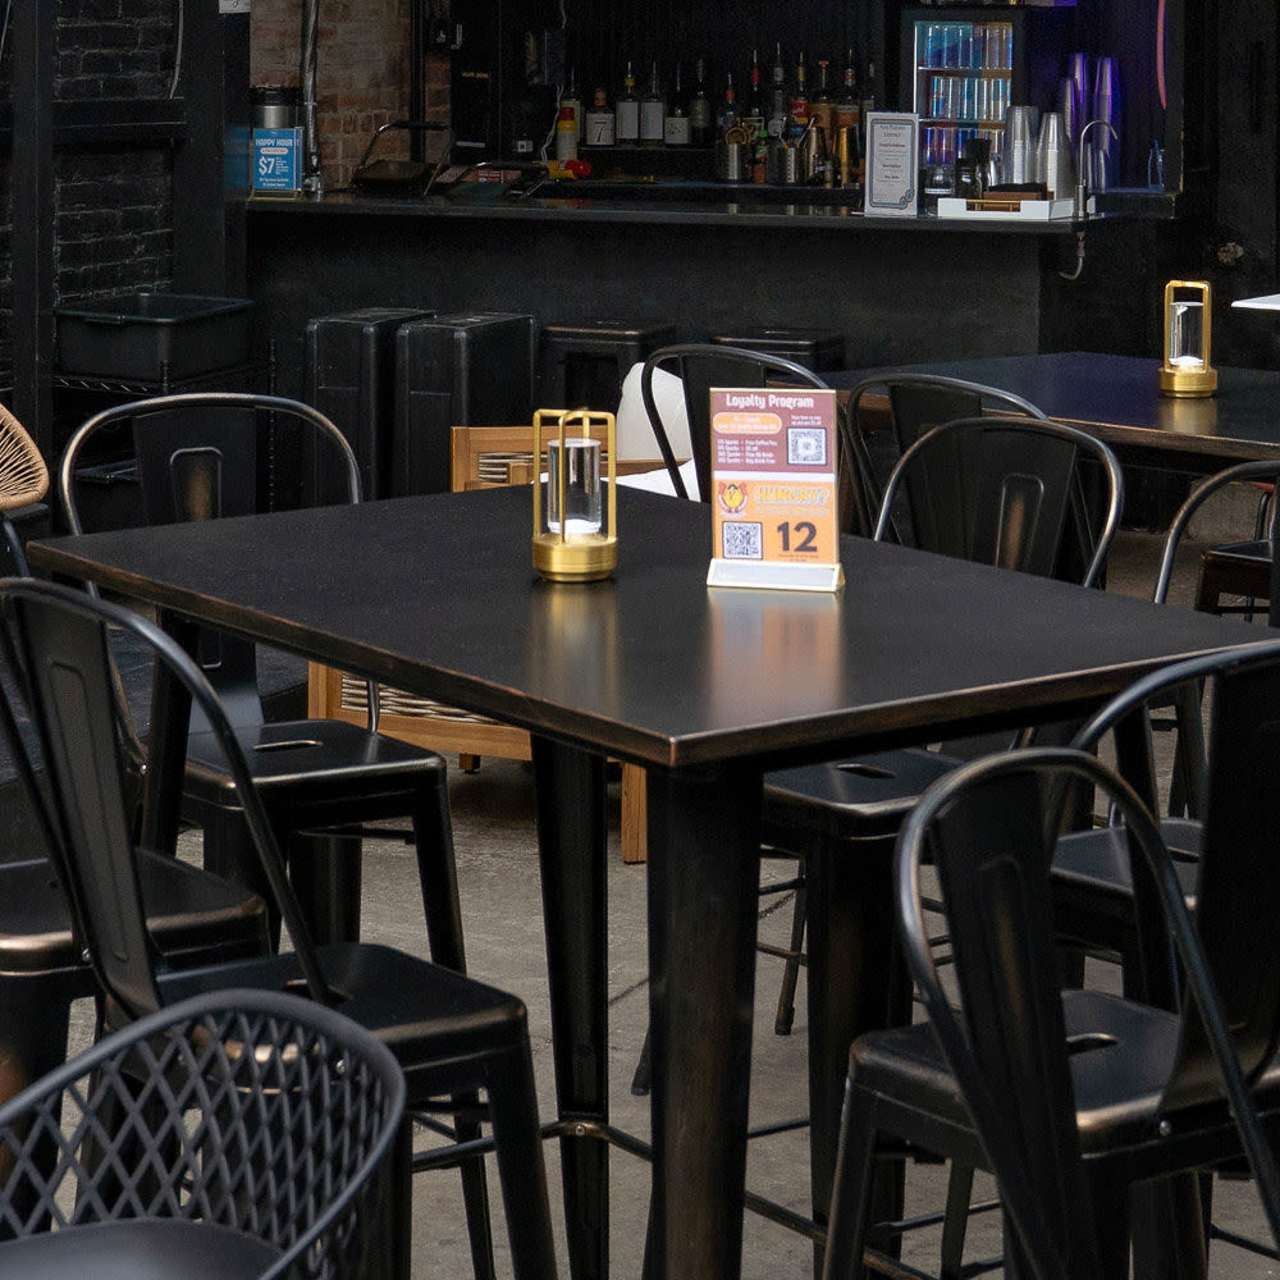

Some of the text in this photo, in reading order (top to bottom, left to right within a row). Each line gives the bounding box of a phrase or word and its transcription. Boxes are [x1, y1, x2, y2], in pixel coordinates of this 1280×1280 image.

[258, 156, 275, 176] $7
[725, 393, 814, 410] Loyalty Program
[777, 521, 818, 552] 12
